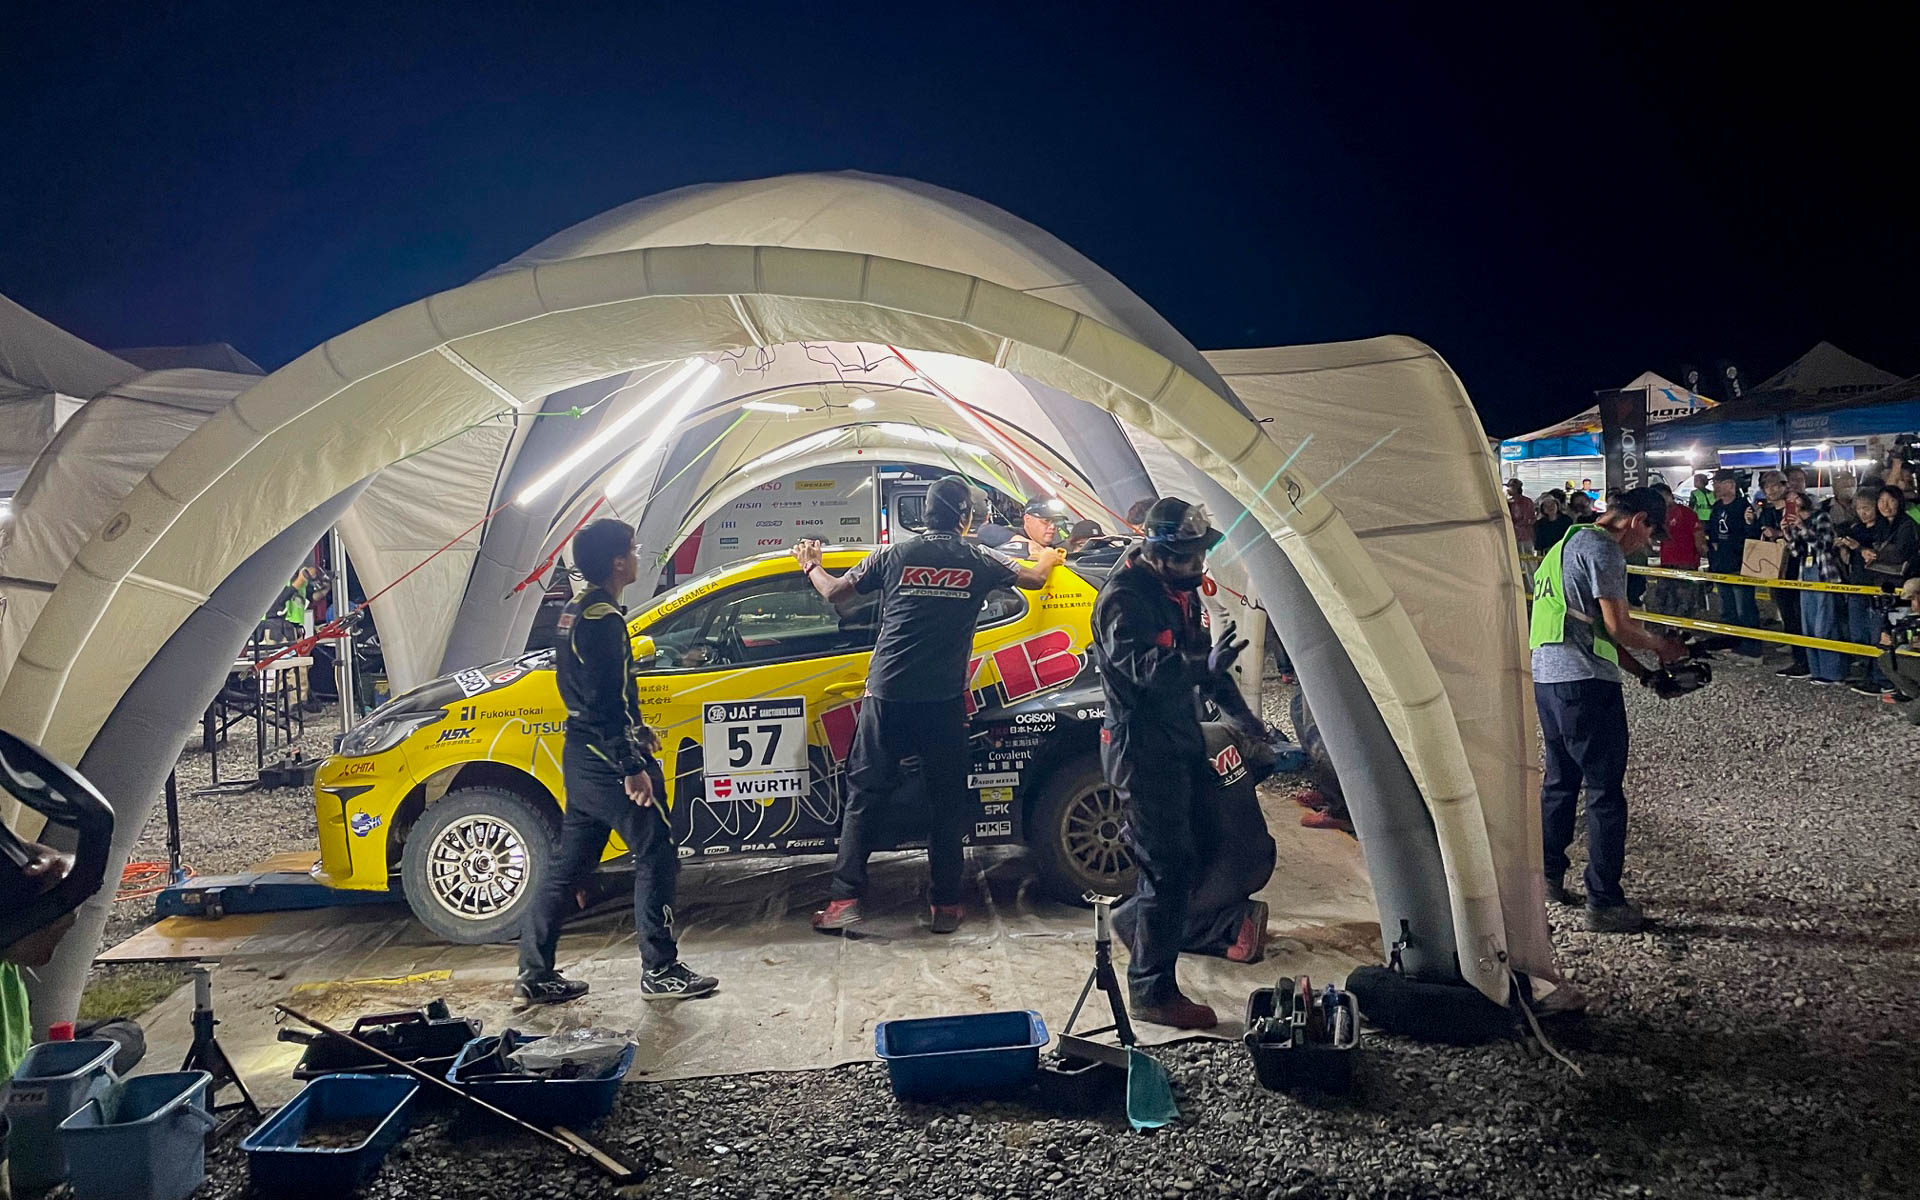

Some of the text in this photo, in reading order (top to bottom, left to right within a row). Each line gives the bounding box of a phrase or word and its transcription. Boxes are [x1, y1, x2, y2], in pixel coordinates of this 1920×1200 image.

[757, 482, 782, 492] NSO
[900, 566, 973, 588] KYB
[665, 581, 719, 612] CERAMETA
[480, 706, 543, 719] Fukoku Tokai
[728, 706, 757, 719] JAF
[1015, 712, 1056, 724] OGISON
[1010, 724, 1056, 733] 日本トムソン
[728, 724, 782, 767] 57
[989, 750, 1032, 760] Covalent
[350, 762, 375, 774] CHITA
[985, 803, 1010, 814] SPK
[976, 822, 1011, 833] HKS
[740, 843, 777, 851] PIAA
